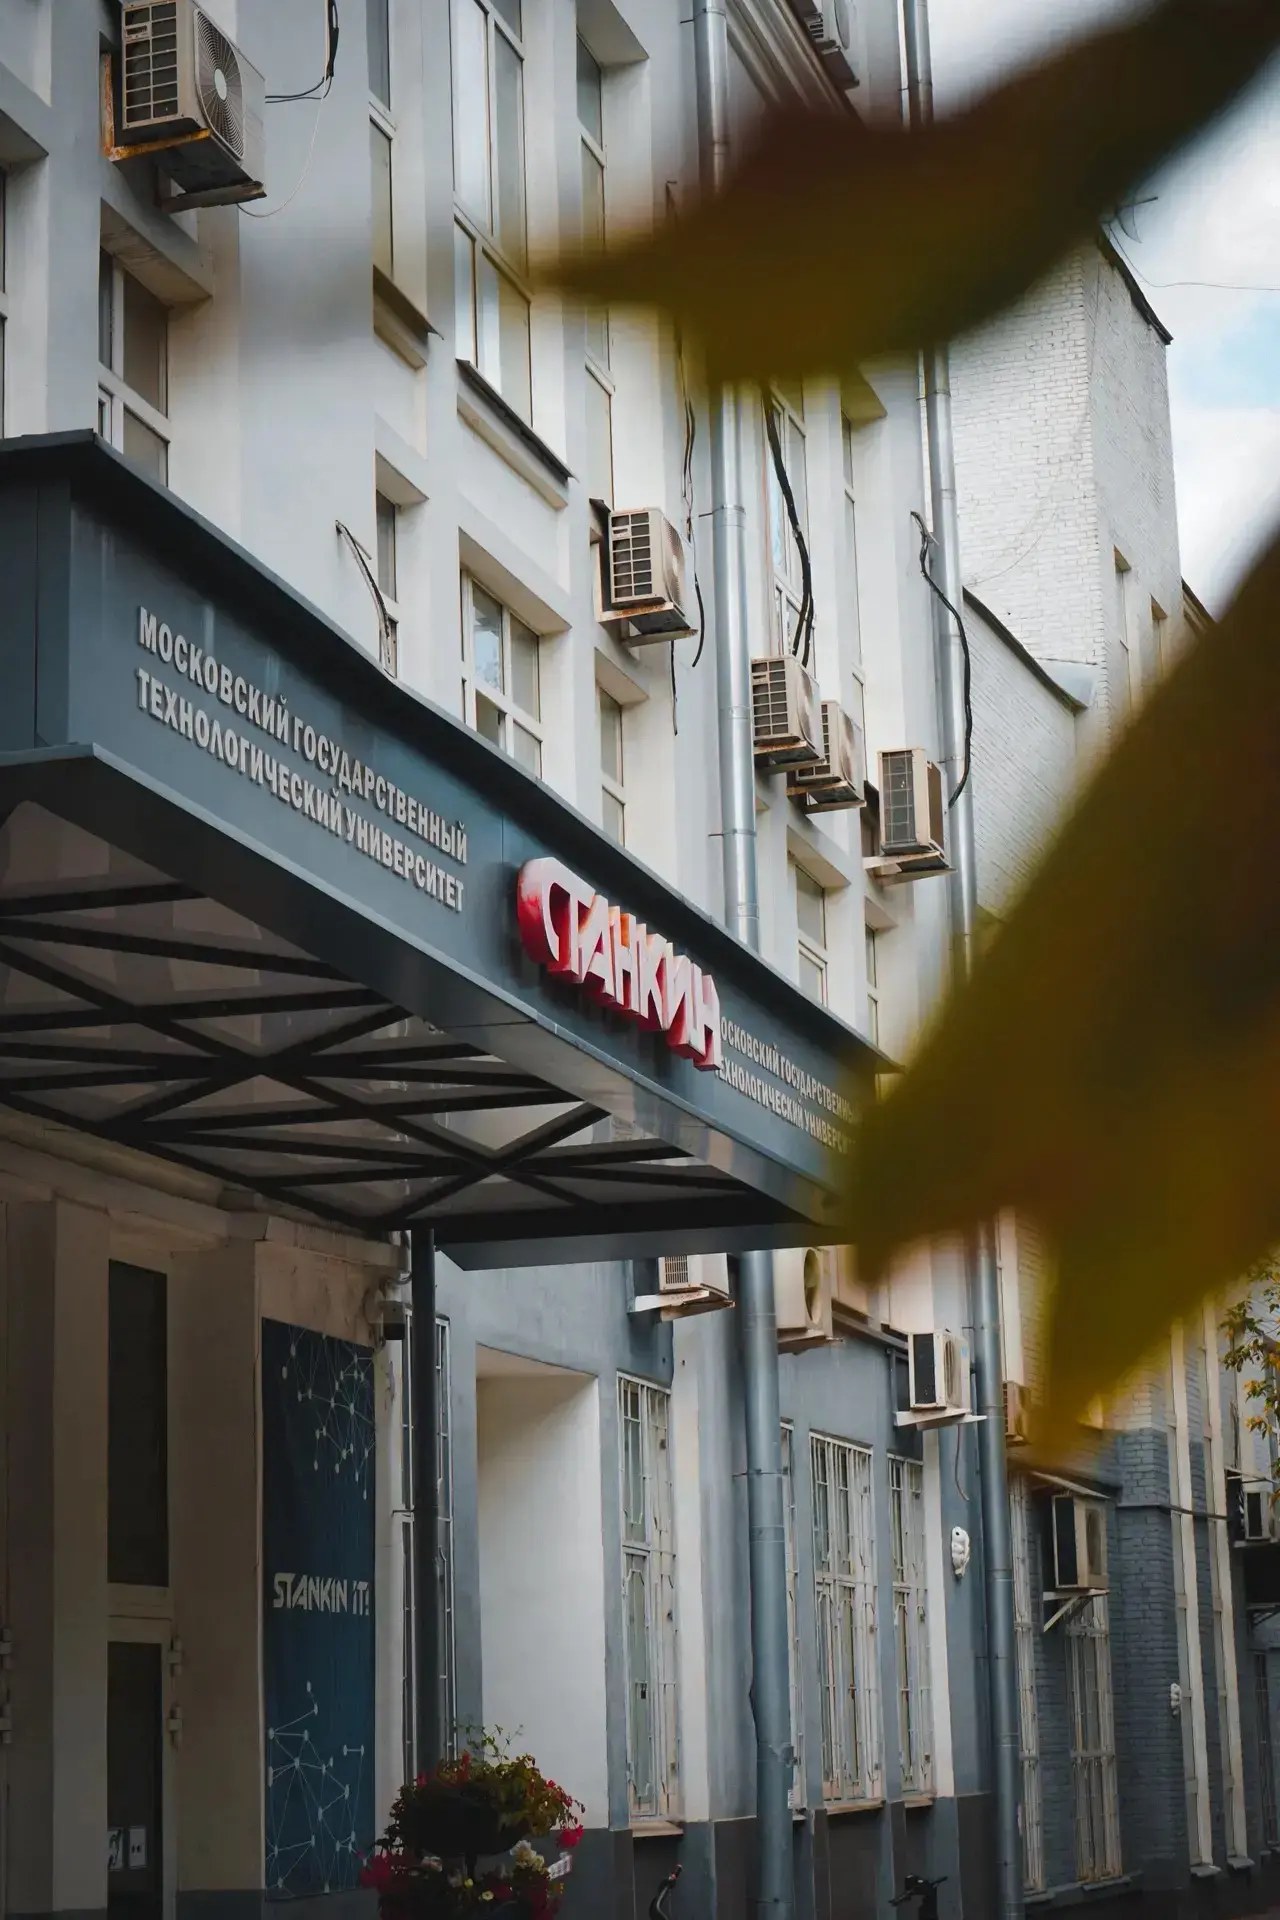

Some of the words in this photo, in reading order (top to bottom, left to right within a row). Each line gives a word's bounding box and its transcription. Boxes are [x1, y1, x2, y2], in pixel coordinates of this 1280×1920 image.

[137, 667, 342, 837] ТЕХНОЛОГИЧЕСКИЙ
[344, 807, 465, 912] УНИВЕРСИТЕТ
[138, 606, 289, 745] МОСКОВСКИЙ
[292, 716, 468, 864] ГОСУДАРСТВЕННЫЙ
[517, 856, 722, 1072] СТАНКИН
[715, 1054, 804, 1130] ЕХНОЛОГИЧЕСКИЙ
[720, 1016, 779, 1077] ОСКОВСКИЙ
[273, 1572, 348, 1613] STANKIN
